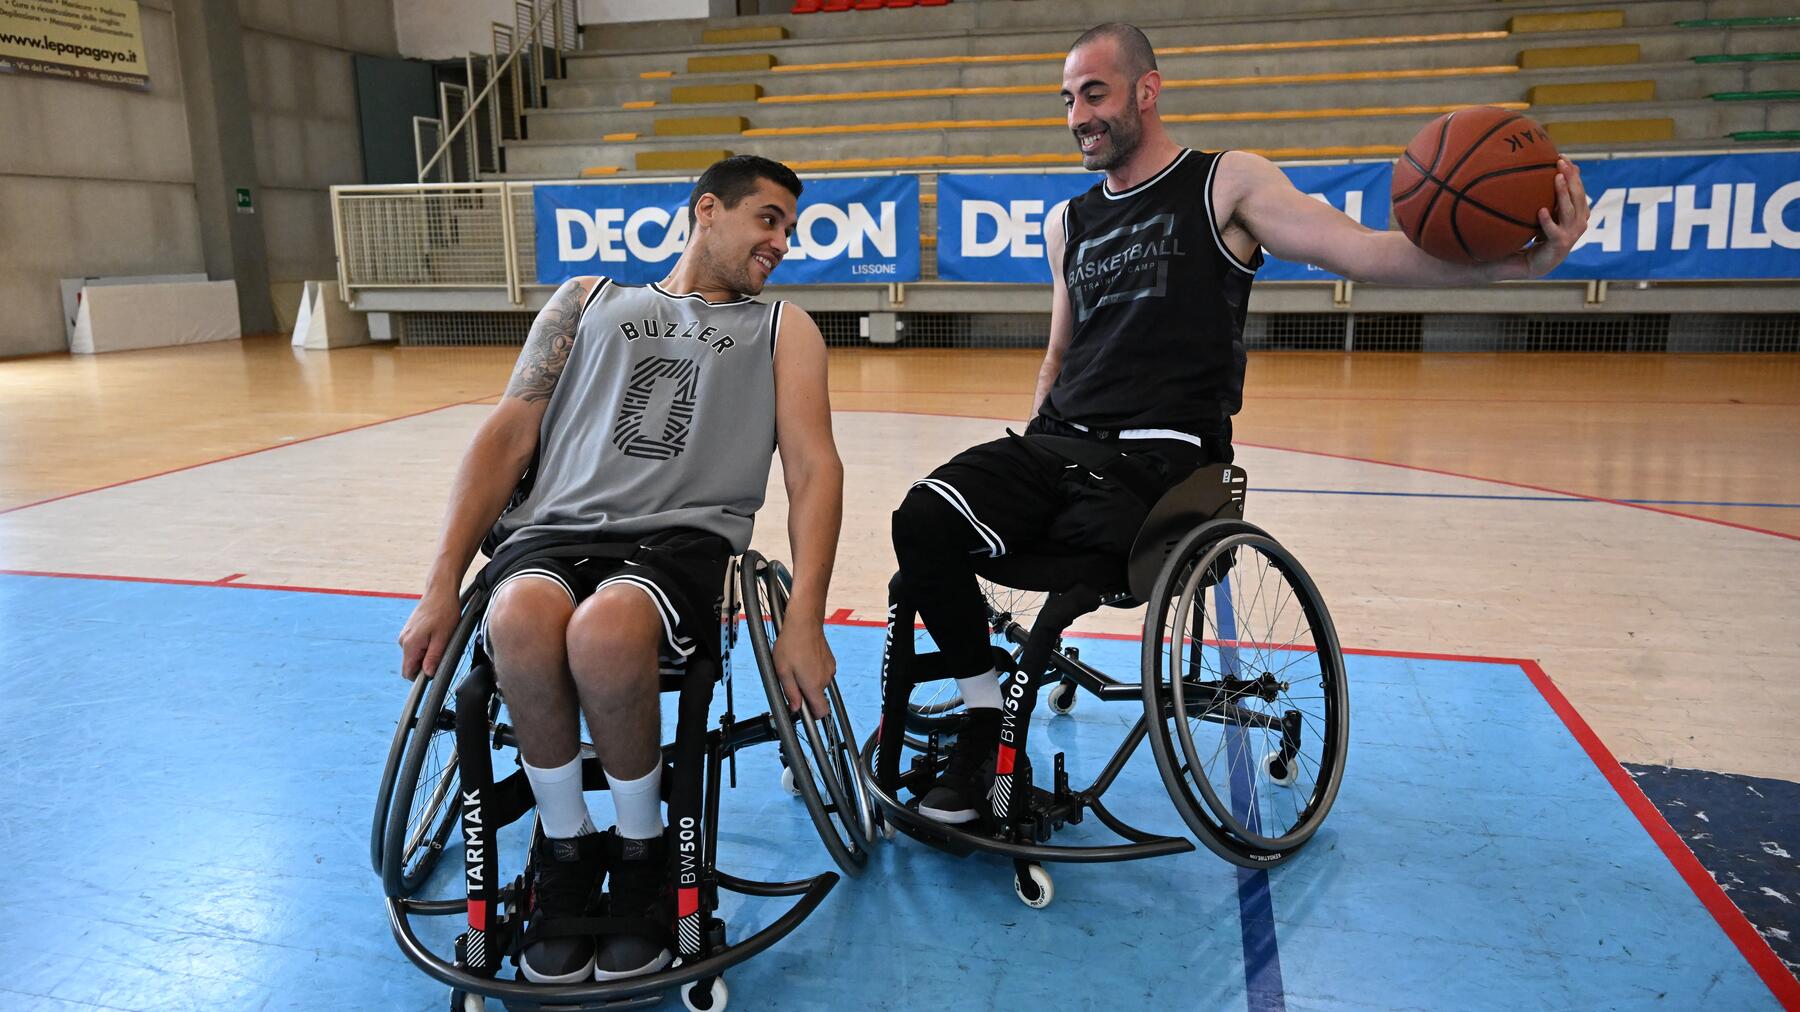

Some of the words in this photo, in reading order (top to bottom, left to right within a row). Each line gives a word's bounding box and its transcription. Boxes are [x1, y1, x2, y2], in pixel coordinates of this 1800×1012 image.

[0, 33, 137, 64] www.lepapagayo.it
[852, 264, 896, 275] LISSONE
[1068, 239, 1186, 288] BASKETBALL
[619, 319, 736, 355] BUZZER
[1000, 670, 1029, 743] BW500
[463, 788, 484, 894] TARMAK
[679, 816, 697, 886] BW500
